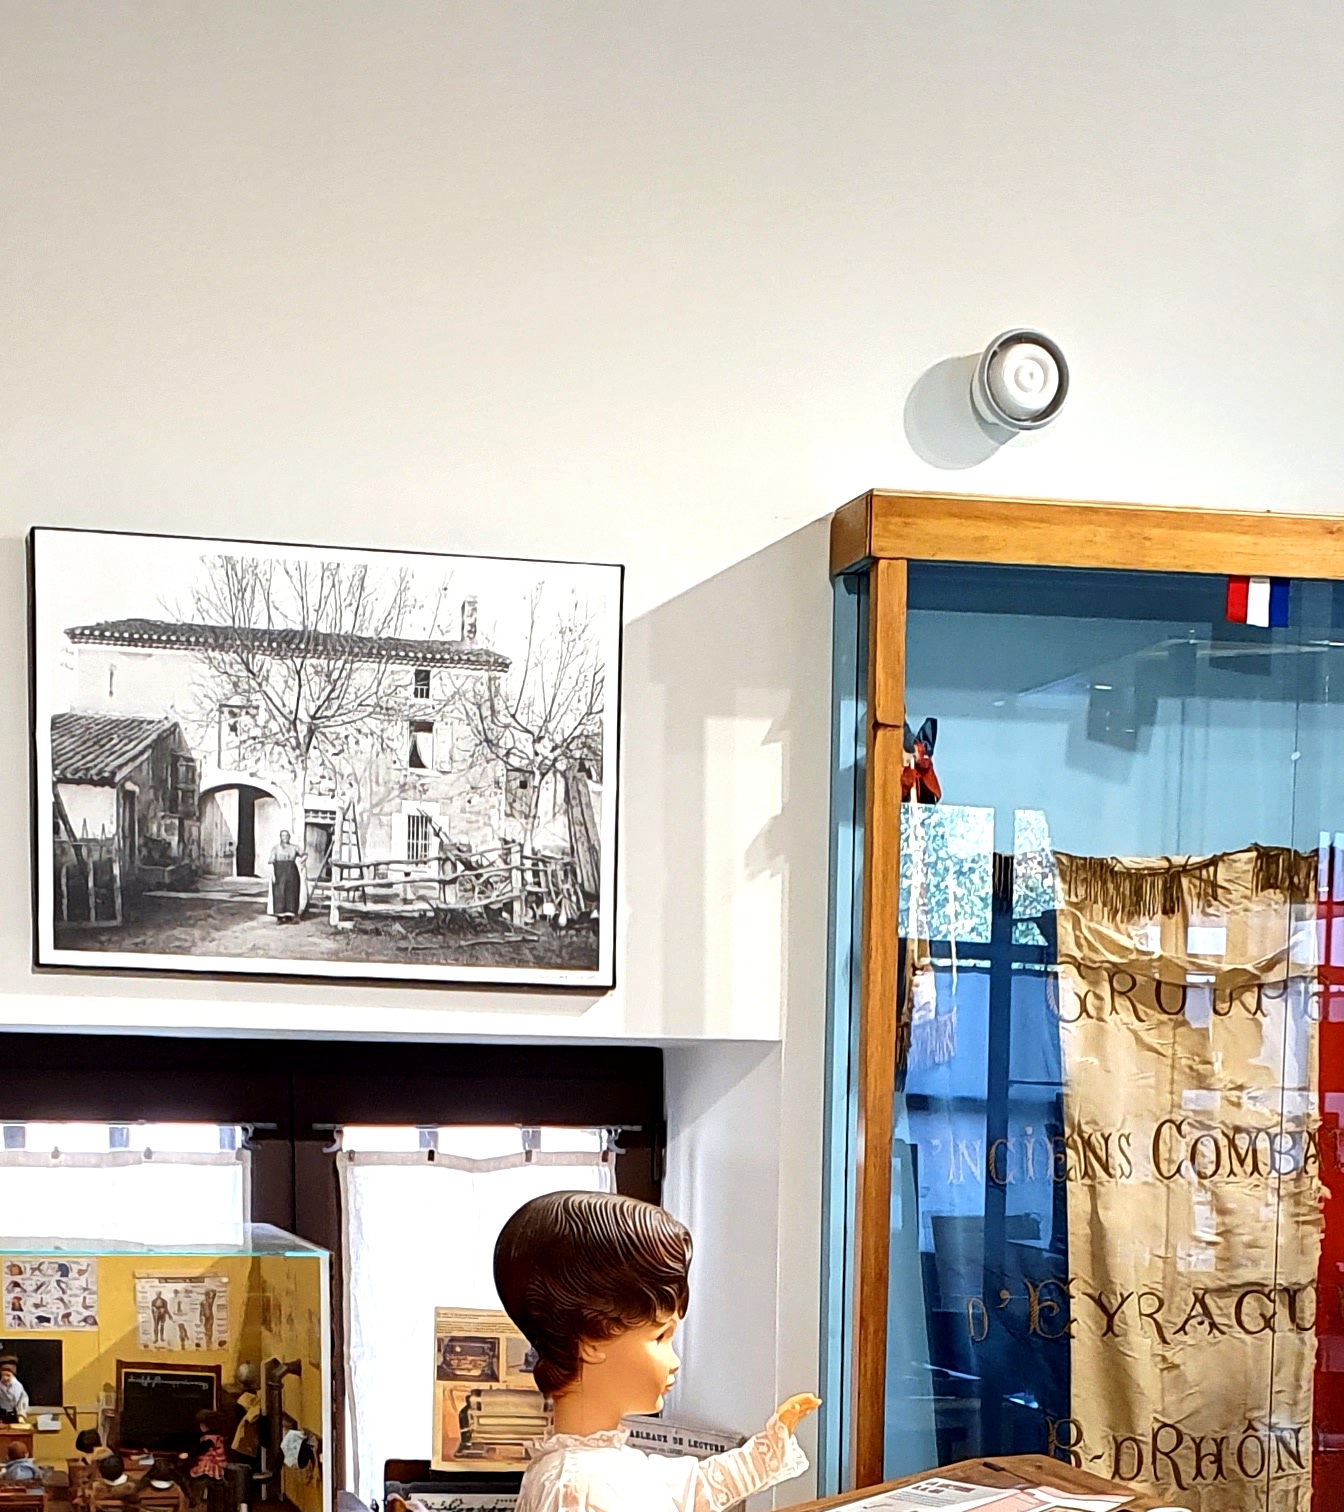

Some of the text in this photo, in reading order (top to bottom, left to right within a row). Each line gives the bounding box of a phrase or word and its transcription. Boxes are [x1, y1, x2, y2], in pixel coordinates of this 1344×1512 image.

[628, 1429, 726, 1453] ABLEAUX DE LECTURE
